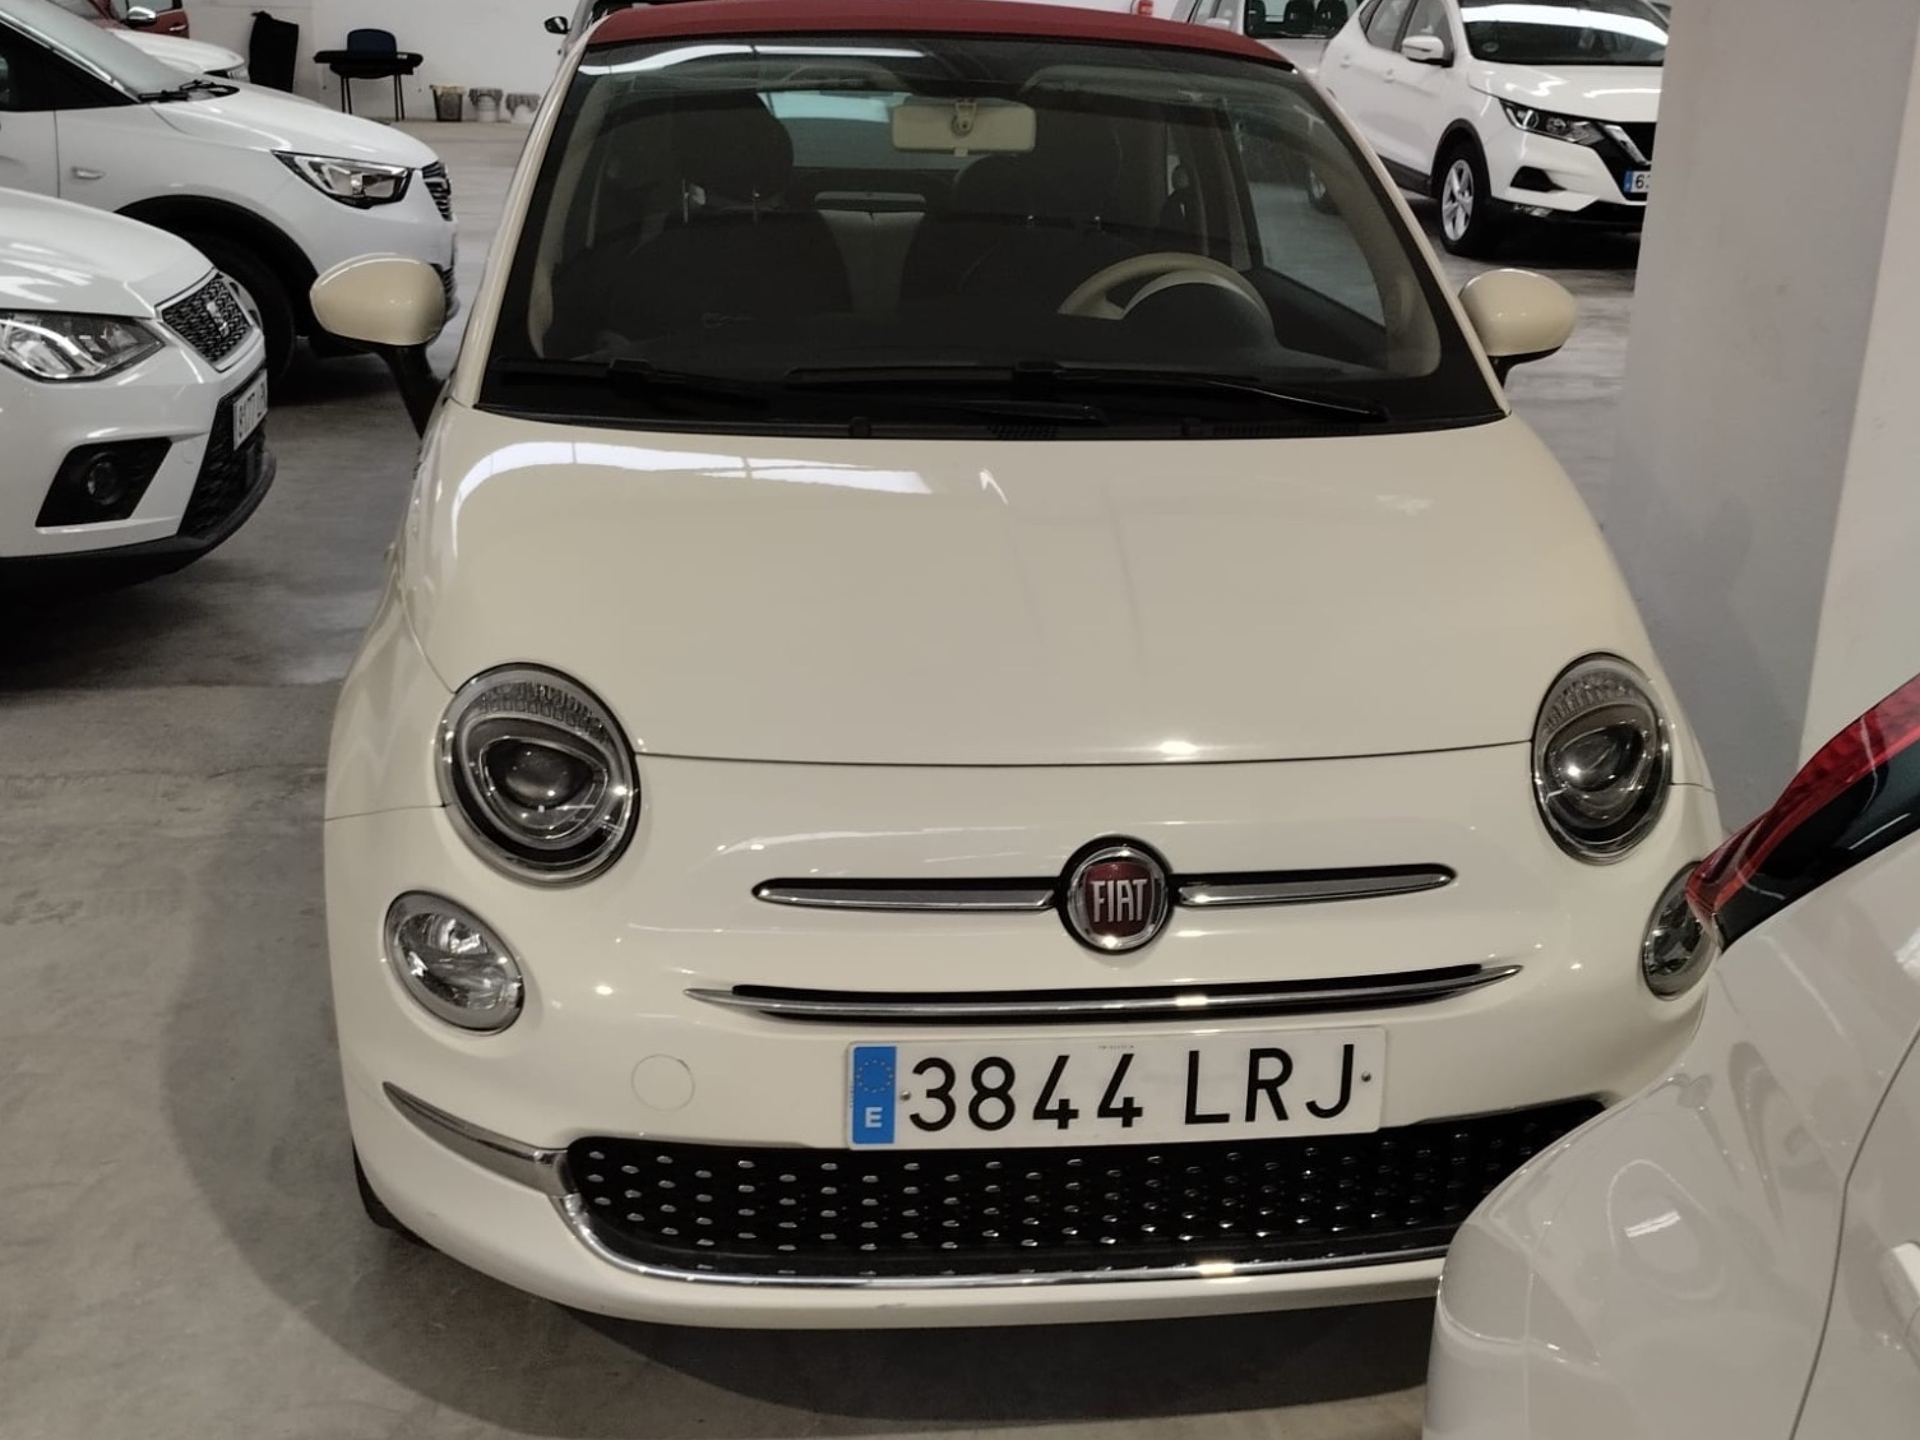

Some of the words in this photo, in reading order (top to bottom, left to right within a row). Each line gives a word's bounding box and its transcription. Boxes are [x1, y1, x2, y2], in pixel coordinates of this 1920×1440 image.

[1091, 878, 1148, 923] FIAT
[865, 1106, 883, 1128] E
[909, 1054, 1144, 1132] 3844
[1184, 1044, 1355, 1125] LRJ
